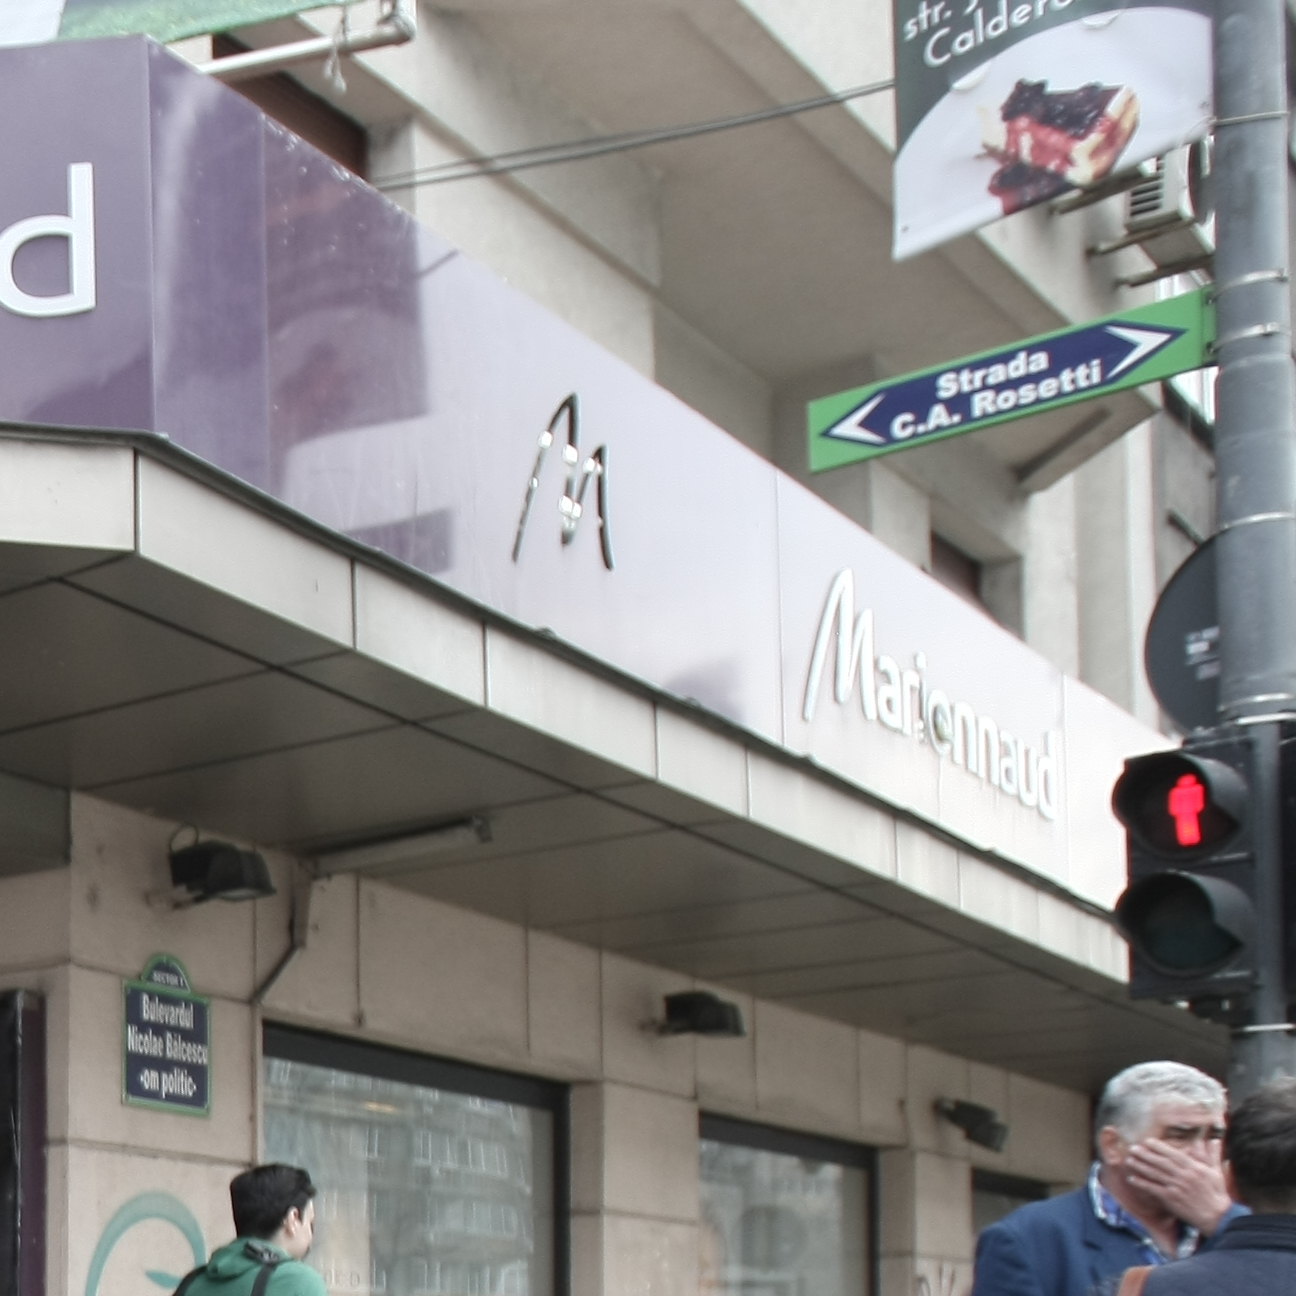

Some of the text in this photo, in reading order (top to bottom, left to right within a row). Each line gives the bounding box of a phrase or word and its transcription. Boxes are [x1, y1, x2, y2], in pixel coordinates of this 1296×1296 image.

[890, 358, 1103, 441] C.A. Rosetti
[935, 348, 1049, 400] Strada
[802, 567, 1057, 822] Marionnaud
[141, 992, 194, 1029] Bulevardul
[127, 1023, 164, 1058] Nicolae
